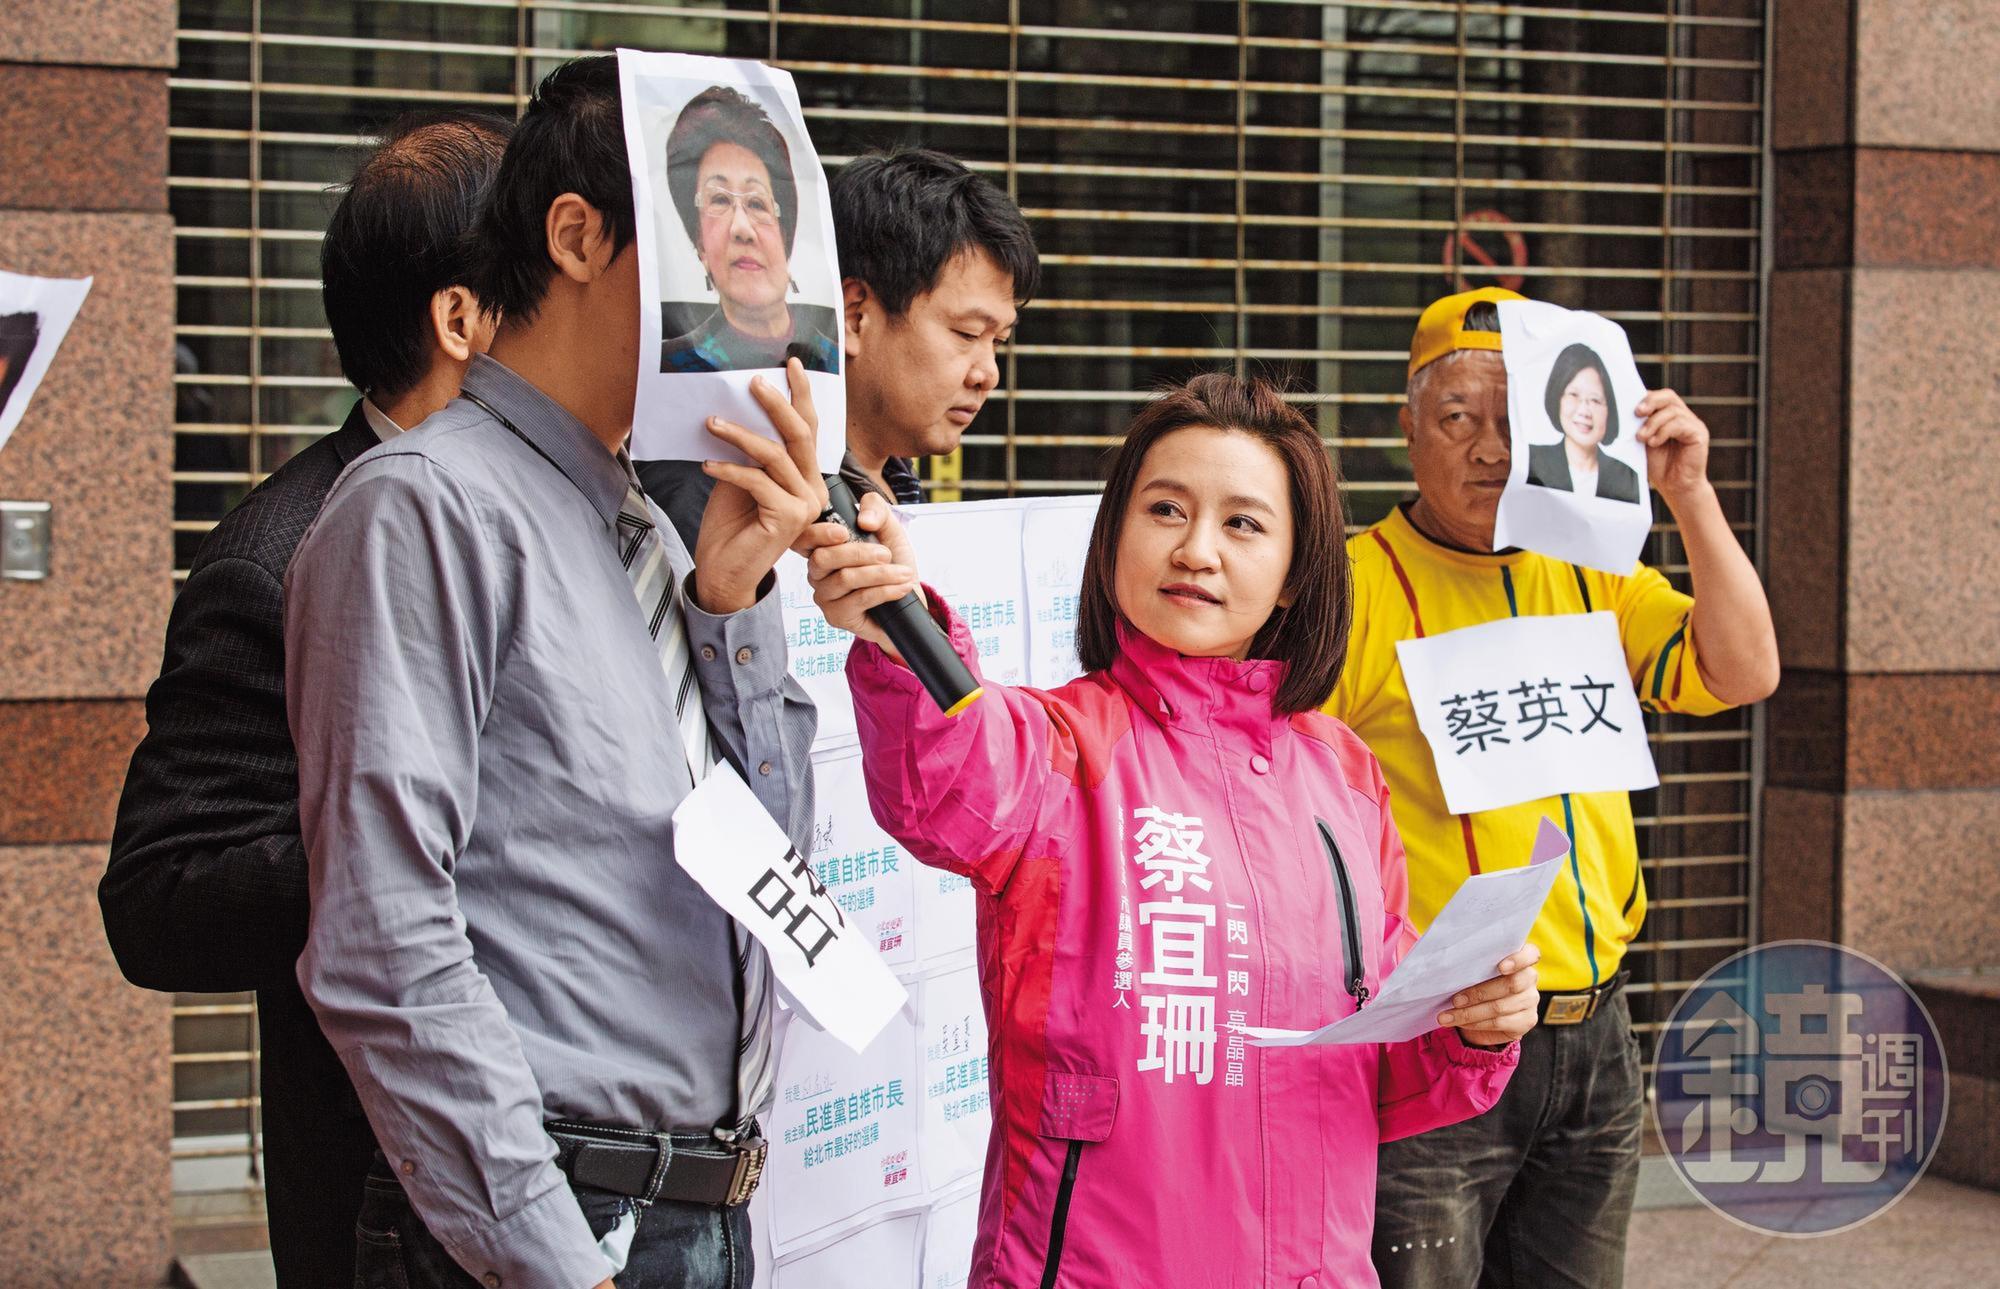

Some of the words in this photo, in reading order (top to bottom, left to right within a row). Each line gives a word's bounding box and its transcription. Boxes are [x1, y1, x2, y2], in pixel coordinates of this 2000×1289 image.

[1440, 674, 1622, 755] 蔡英文
[1133, 805, 1218, 1086] 蔡宜珊
[1225, 902, 1249, 997] 一閃一閃
